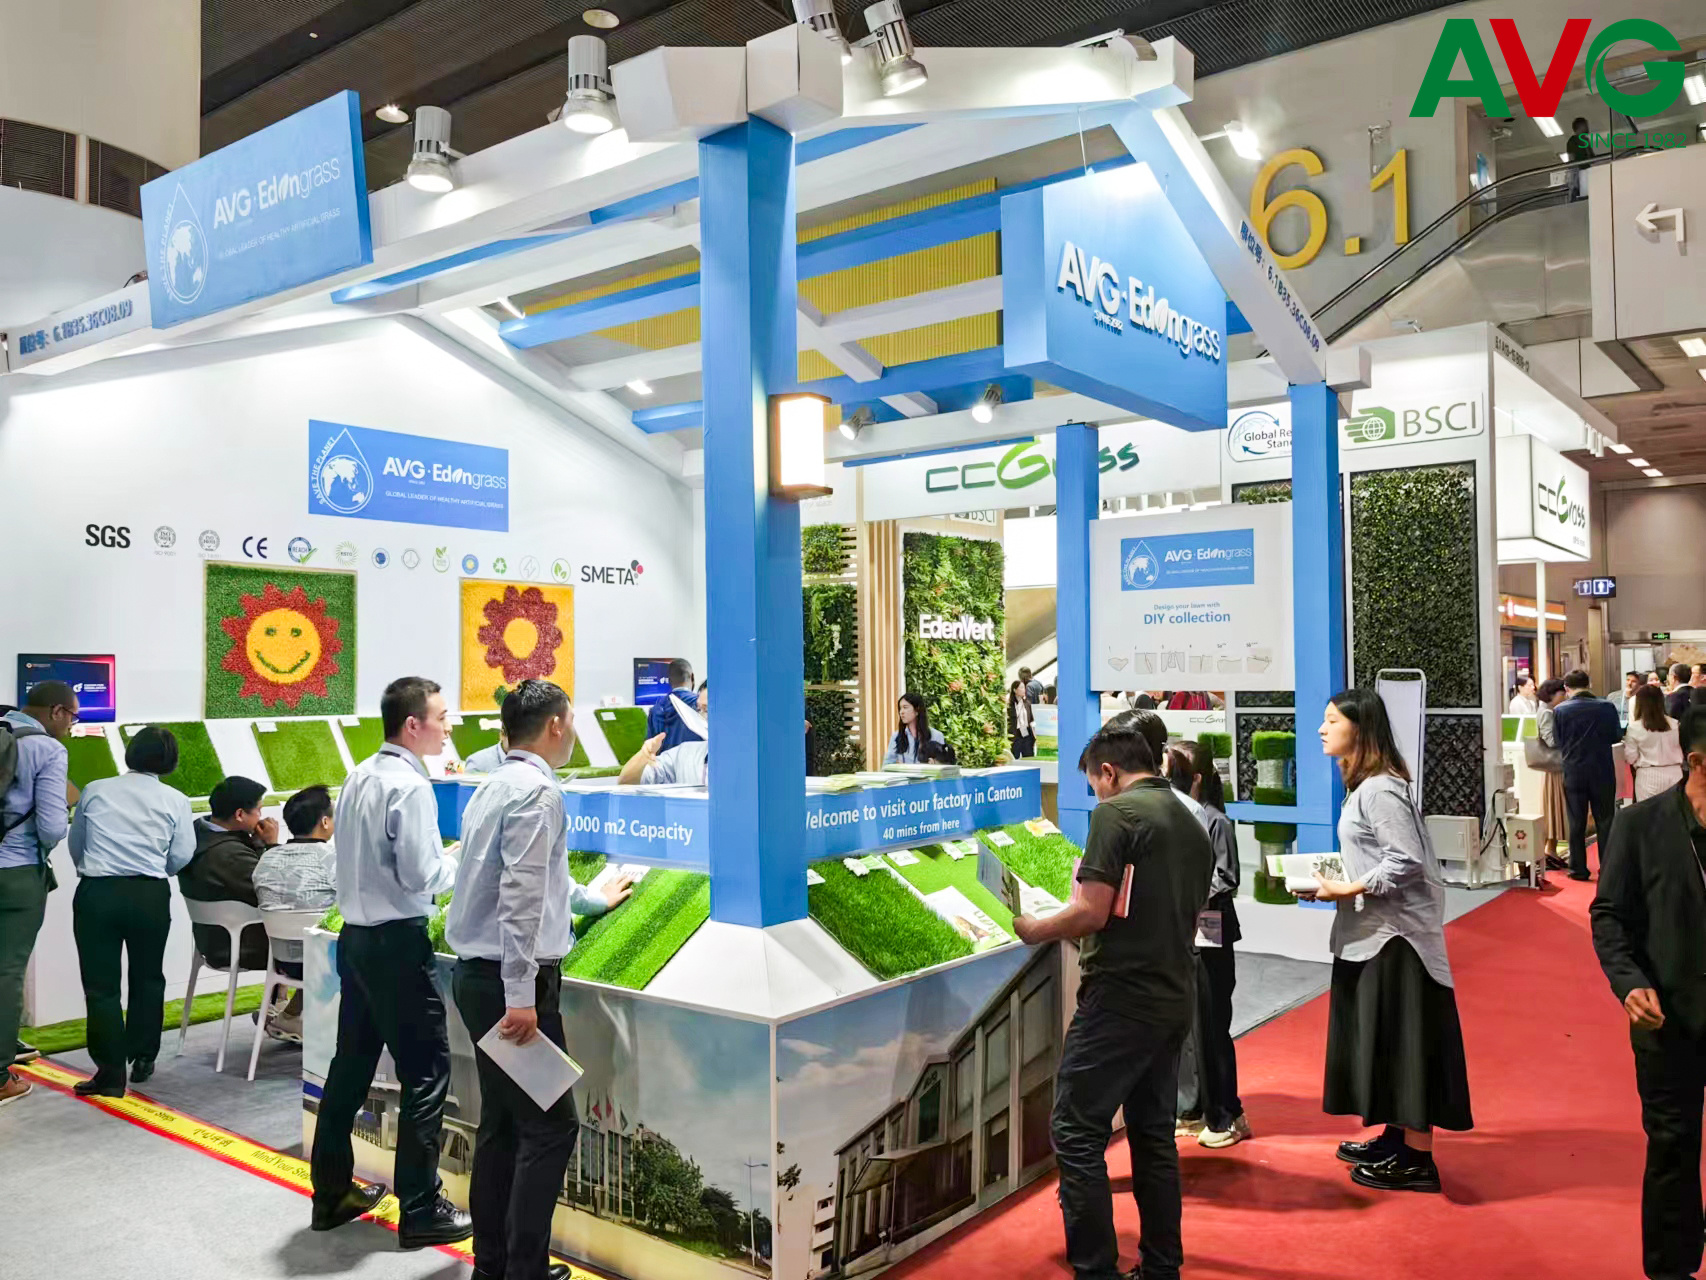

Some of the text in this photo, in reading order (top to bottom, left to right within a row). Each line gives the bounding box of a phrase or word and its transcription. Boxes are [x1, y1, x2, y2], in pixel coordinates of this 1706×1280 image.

[214, 188, 250, 229] AVG
[1250, 147, 1409, 270] 6.1
[1057, 240, 1120, 315] AVG
[1403, 401, 1476, 437] BSCI
[1244, 428, 1292, 442] Global Re
[1267, 439, 1292, 449] Stan
[315, 436, 335, 466] PLANET
[382, 456, 426, 479] AVG
[385, 490, 407, 499] GLOBAL
[407, 492, 428, 501] LEADER
[437, 496, 460, 504] HEALTHY
[85, 523, 131, 549] SGS
[242, 536, 268, 559] CE
[1164, 549, 1193, 562] AVG
[581, 564, 635, 586] SMETA
[1144, 610, 1231, 625] DIY collection
[1175, 603, 1190, 611] your
[919, 614, 995, 641] EdenVert
[863, 804, 877, 820] to
[880, 798, 906, 818] visit
[909, 799, 930, 814] our
[933, 793, 972, 811] factory
[974, 788, 984, 804] in
[987, 786, 1022, 803] Canton
[566, 814, 693, 846] 0,000 m2 Capacity
[883, 818, 960, 840] 40 mins from here
[251, 1150, 272, 1163] Mind
[272, 1156, 294, 1172] Your
